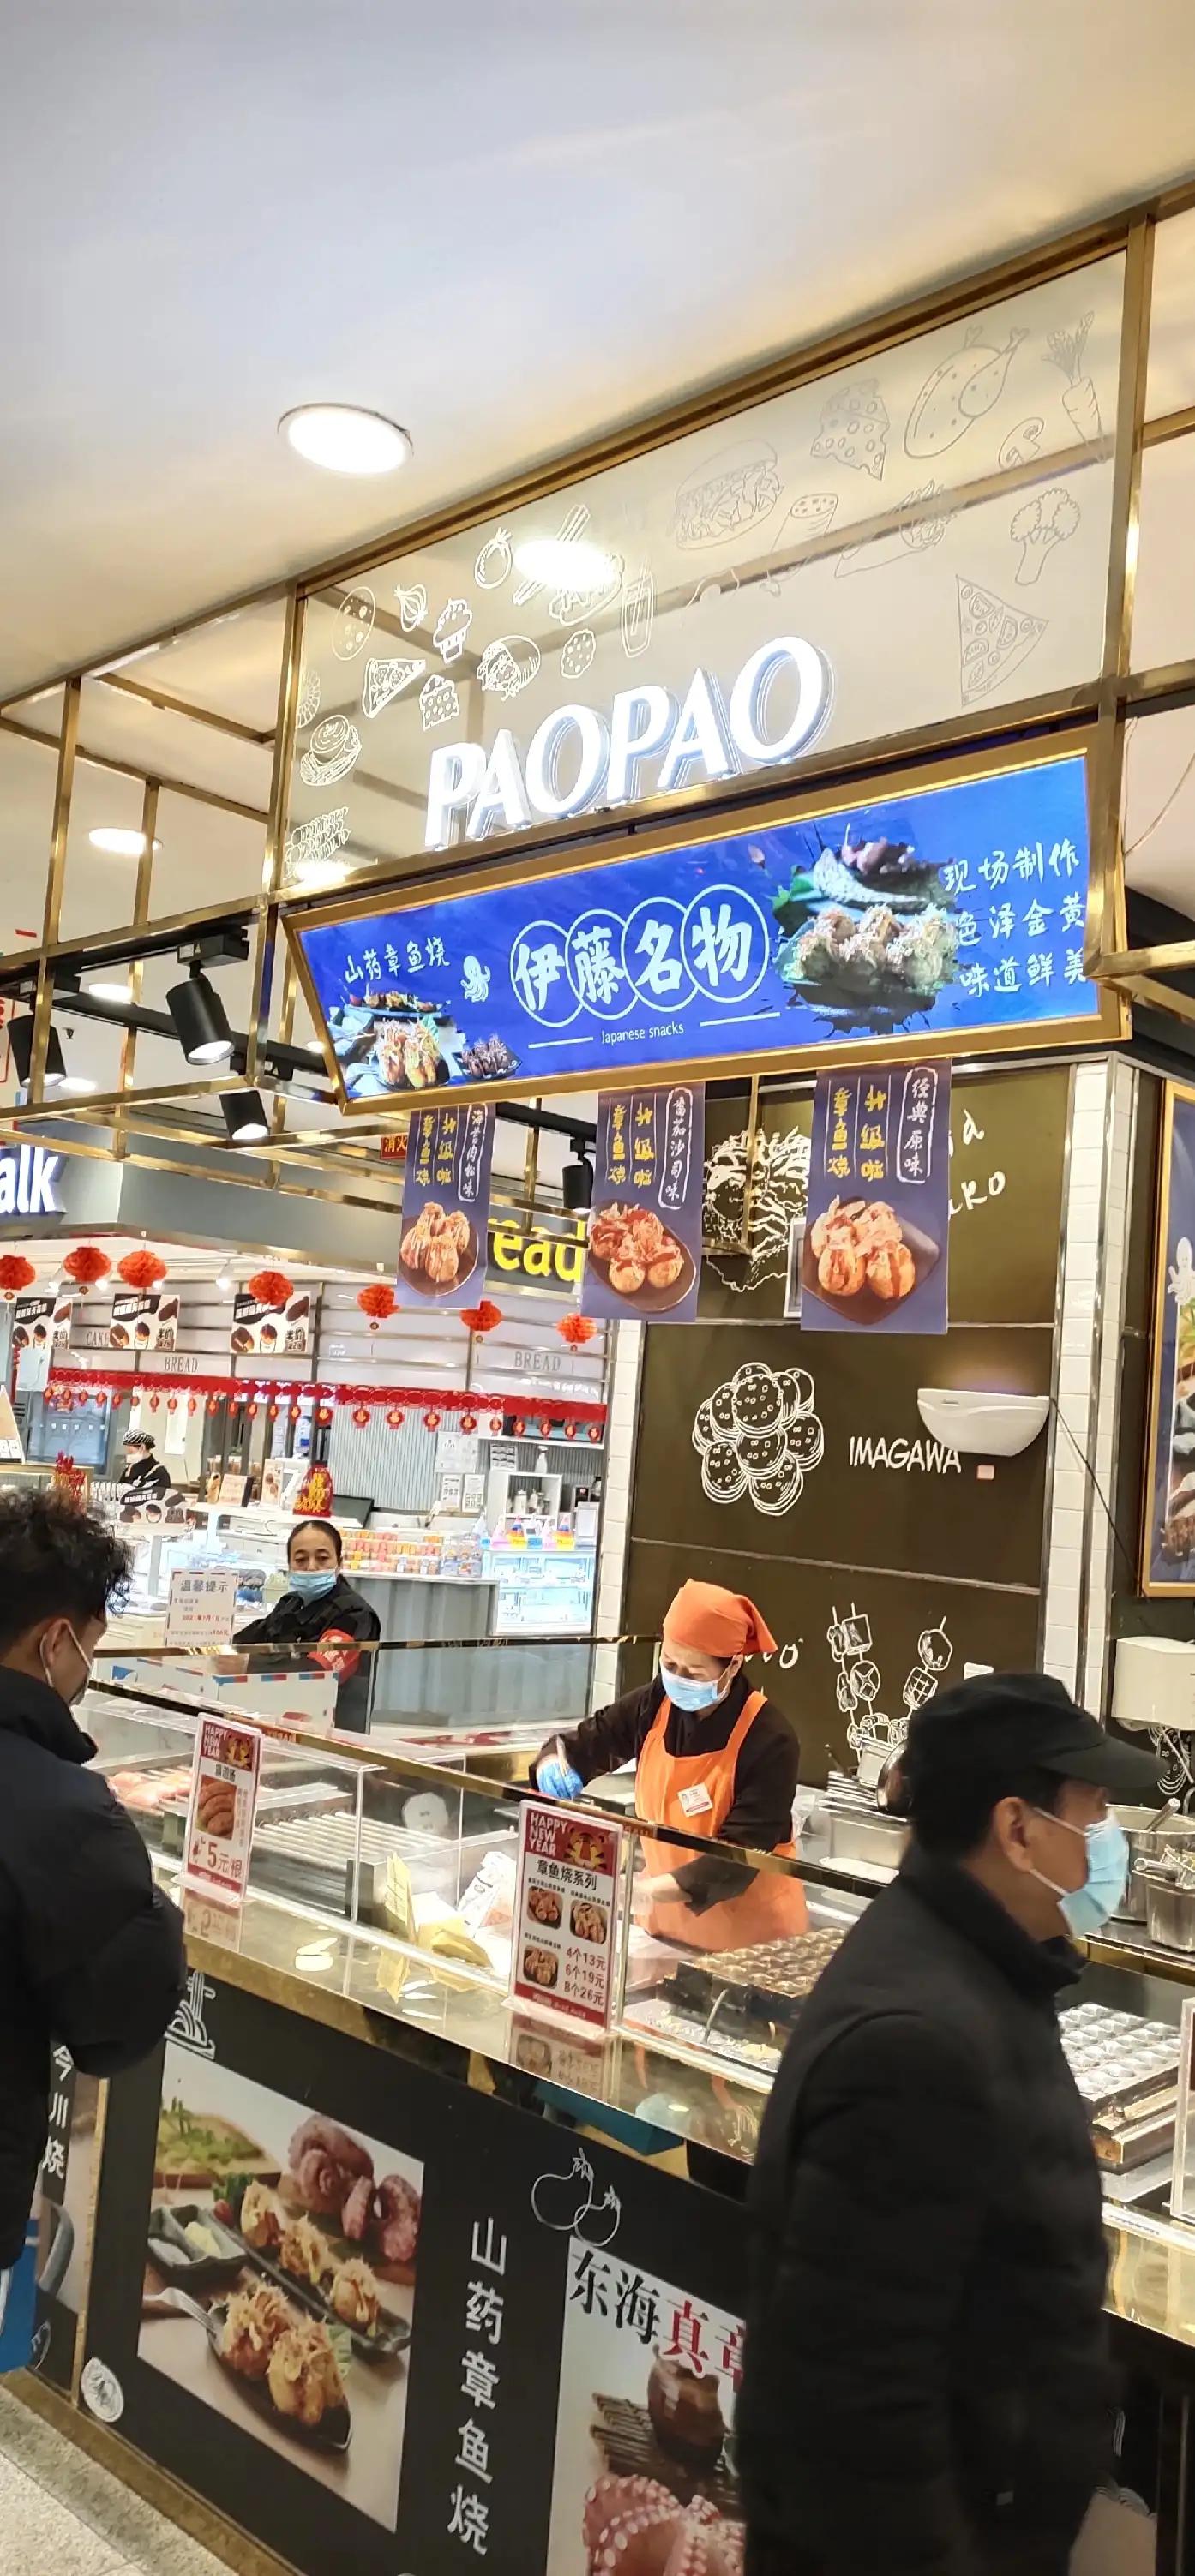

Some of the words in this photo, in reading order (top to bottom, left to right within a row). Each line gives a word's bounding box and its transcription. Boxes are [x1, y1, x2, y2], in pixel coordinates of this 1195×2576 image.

[425, 636, 834, 851] PAOPAO
[943, 837, 1080, 895] 现场制作
[957, 891, 1086, 947] 色泽金黄
[345, 936, 451, 984] 山药章鱼烧
[514, 904, 754, 1012] 伊藤名物
[959, 946, 1087, 997] 味道鲜美
[602, 1028, 646, 1046] Japanese
[648, 1021, 685, 1039] snacks
[415, 1114, 436, 1187] 章鱼烧
[607, 1104, 628, 1186] 章鱼烧
[664, 1096, 687, 1202] 番茄沙司味
[826, 1087, 853, 1180] 章鱼烧
[860, 1084, 888, 1183] 升级啦
[903, 1076, 932, 1178] 经典原味
[488, 1218, 585, 1283] ead
[86, 1331, 110, 1347] CAKE
[164, 1356, 199, 1373] BREAD
[514, 1351, 561, 1371] BREAD
[848, 1435, 962, 1474] IMAGAWA
[529, 1836, 556, 1857] YEAR
[531, 1812, 567, 1835] HAPPY
[531, 1825, 556, 1843] NEW
[537, 1859, 598, 1891] 章鱼烧系列
[566, 1946, 606, 1972] 4个13元
[42, 2045, 75, 2179] 今川烧
[447, 2216, 508, 2556] 山药章鱼烧
